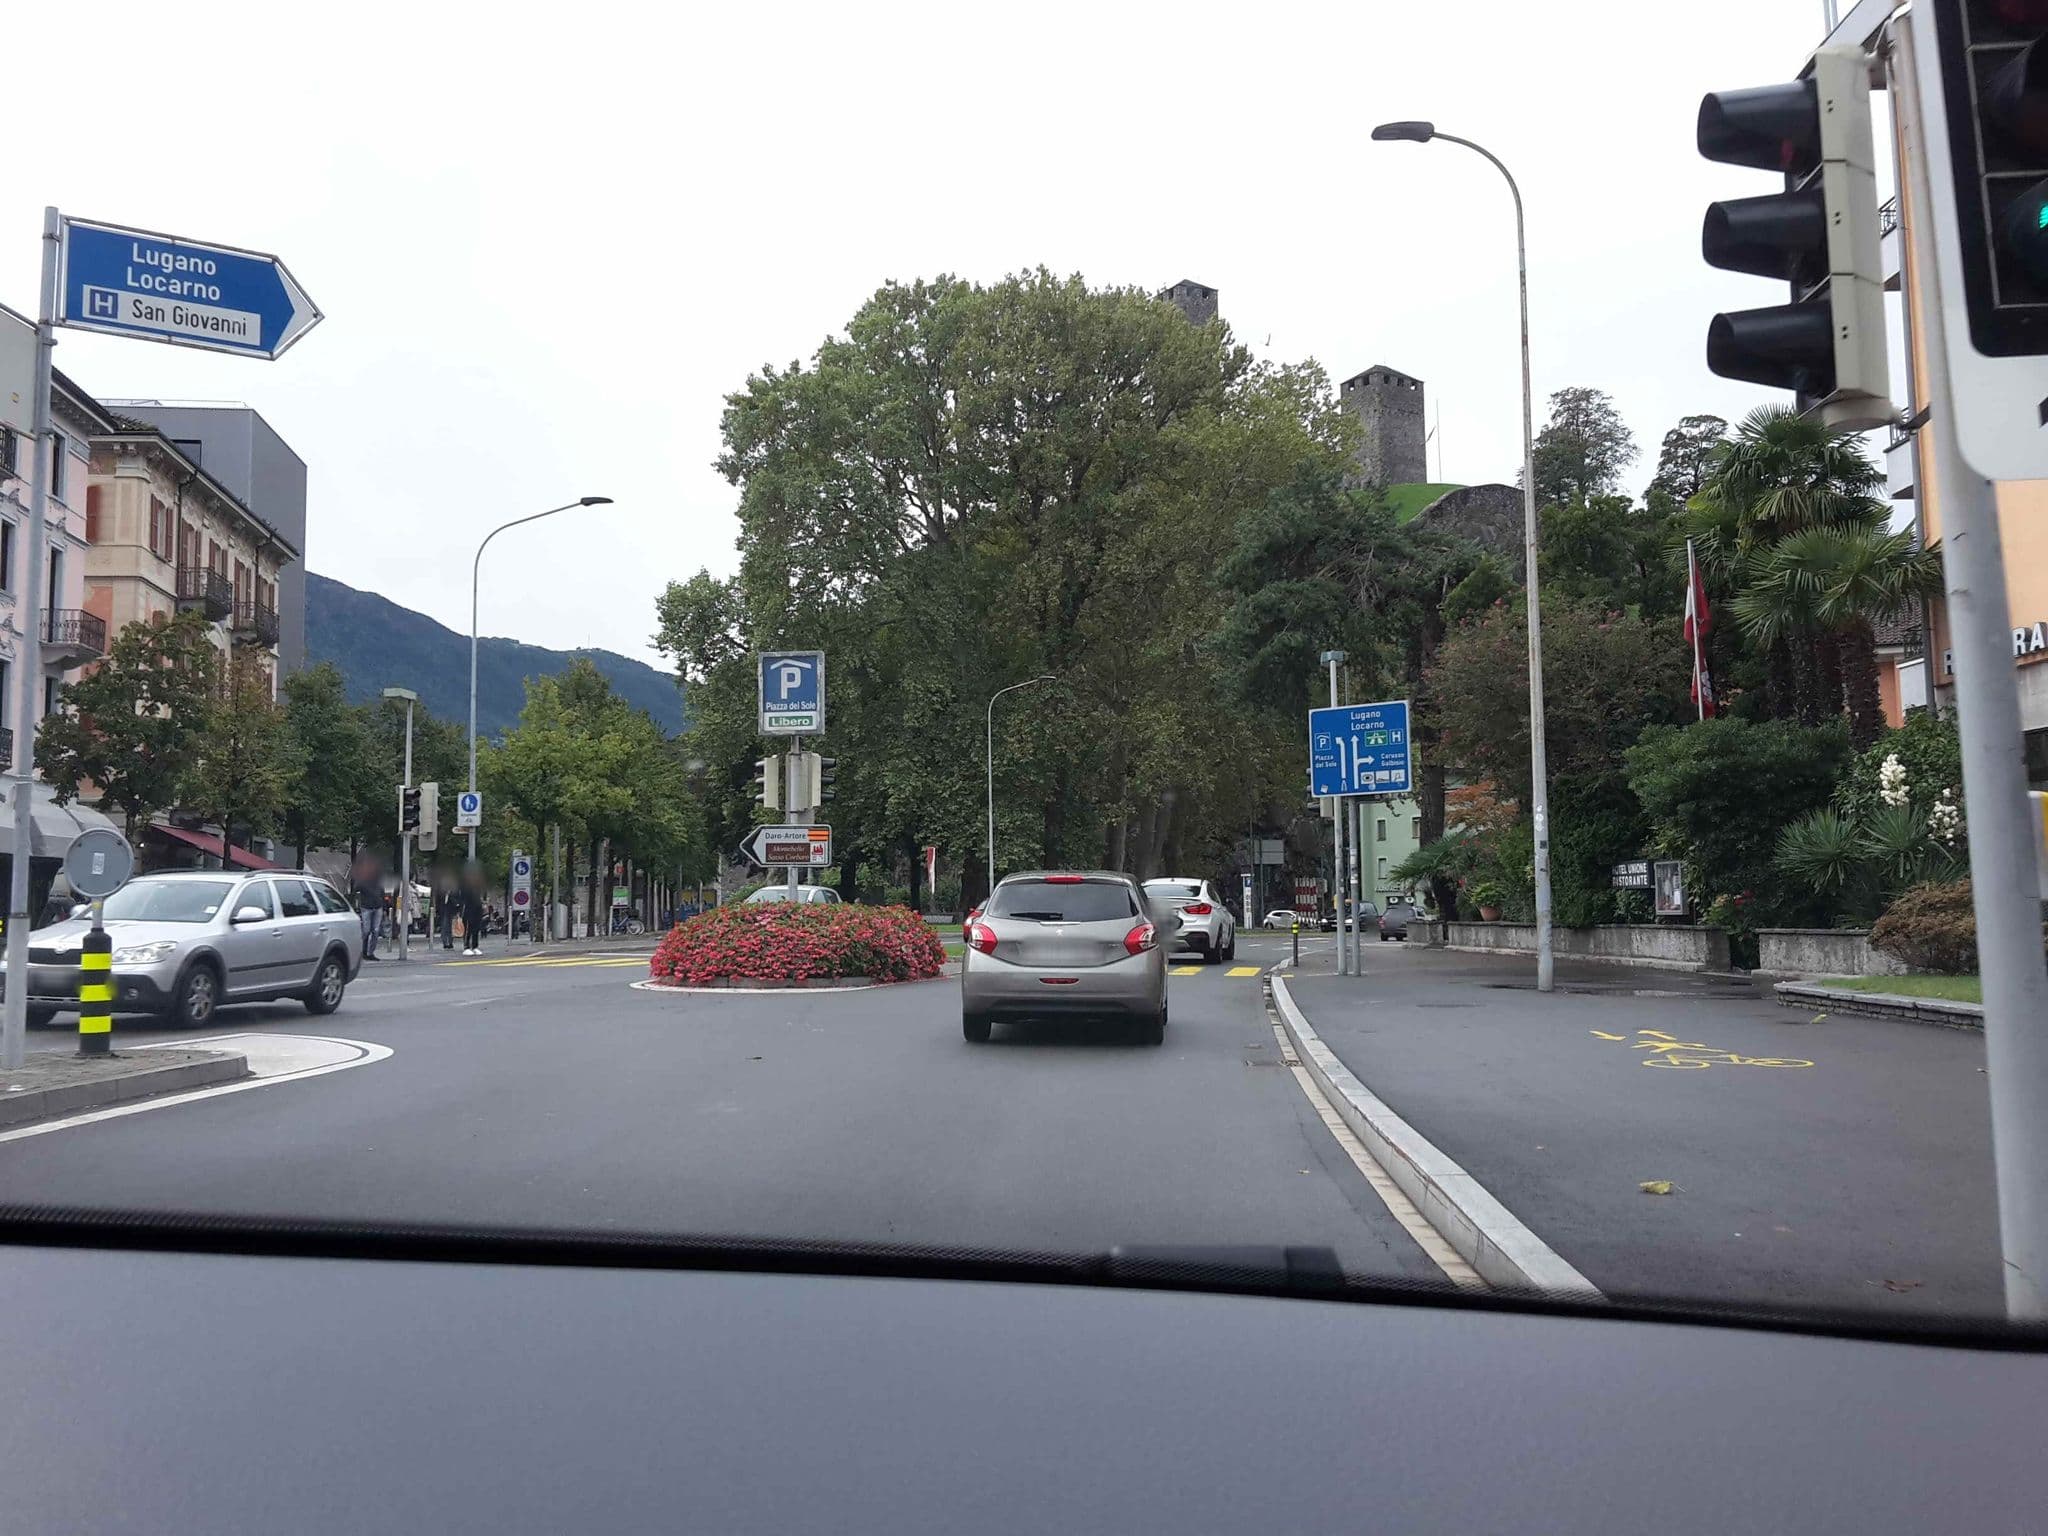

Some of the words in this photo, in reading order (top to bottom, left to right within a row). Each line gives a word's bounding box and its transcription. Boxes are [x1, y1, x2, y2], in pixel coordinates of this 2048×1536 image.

[132, 242, 217, 276] Lugano
[126, 267, 221, 301] Locarno
[94, 291, 114, 315] H
[132, 299, 166, 324] San
[172, 305, 248, 337] Giovanni
[780, 667, 802, 700] P
[765, 702, 787, 711] Piazza
[789, 701, 800, 710] del
[800, 700, 816, 710] Sole
[1350, 710, 1381, 721] Lugano
[771, 717, 810, 726] Libero
[1351, 721, 1385, 731] Locarno
[1391, 731, 1401, 742] H
[1627, 862, 1648, 874] UNIONE
